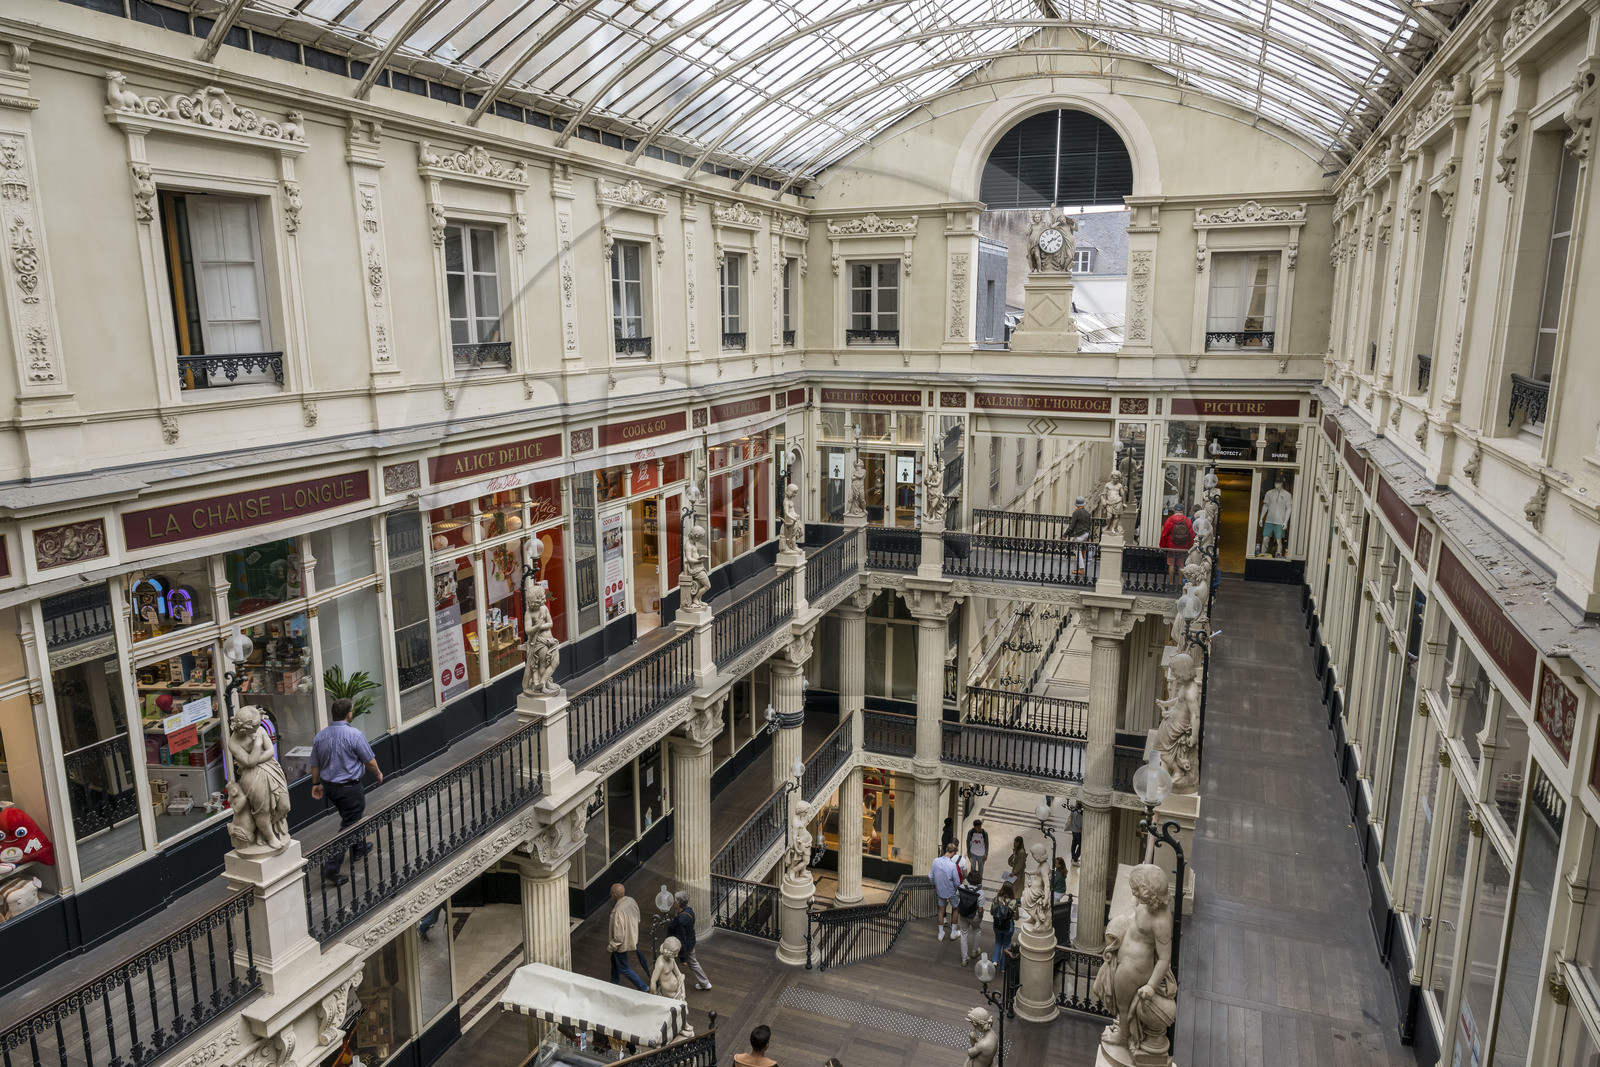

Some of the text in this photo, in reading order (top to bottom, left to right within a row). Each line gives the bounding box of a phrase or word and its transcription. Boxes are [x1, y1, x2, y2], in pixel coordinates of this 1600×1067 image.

[823, 391, 920, 403] ATELIER COQLICO
[977, 396, 1024, 406] GALERIE
[1027, 398, 1040, 408] DE
[1204, 402, 1265, 413] PICTURE
[623, 420, 666, 438] COOK & GO
[454, 442, 543, 474] ALICE DELICE
[147, 479, 354, 539] LA CHAISE LONGUE
[535, 496, 557, 514] Alice
